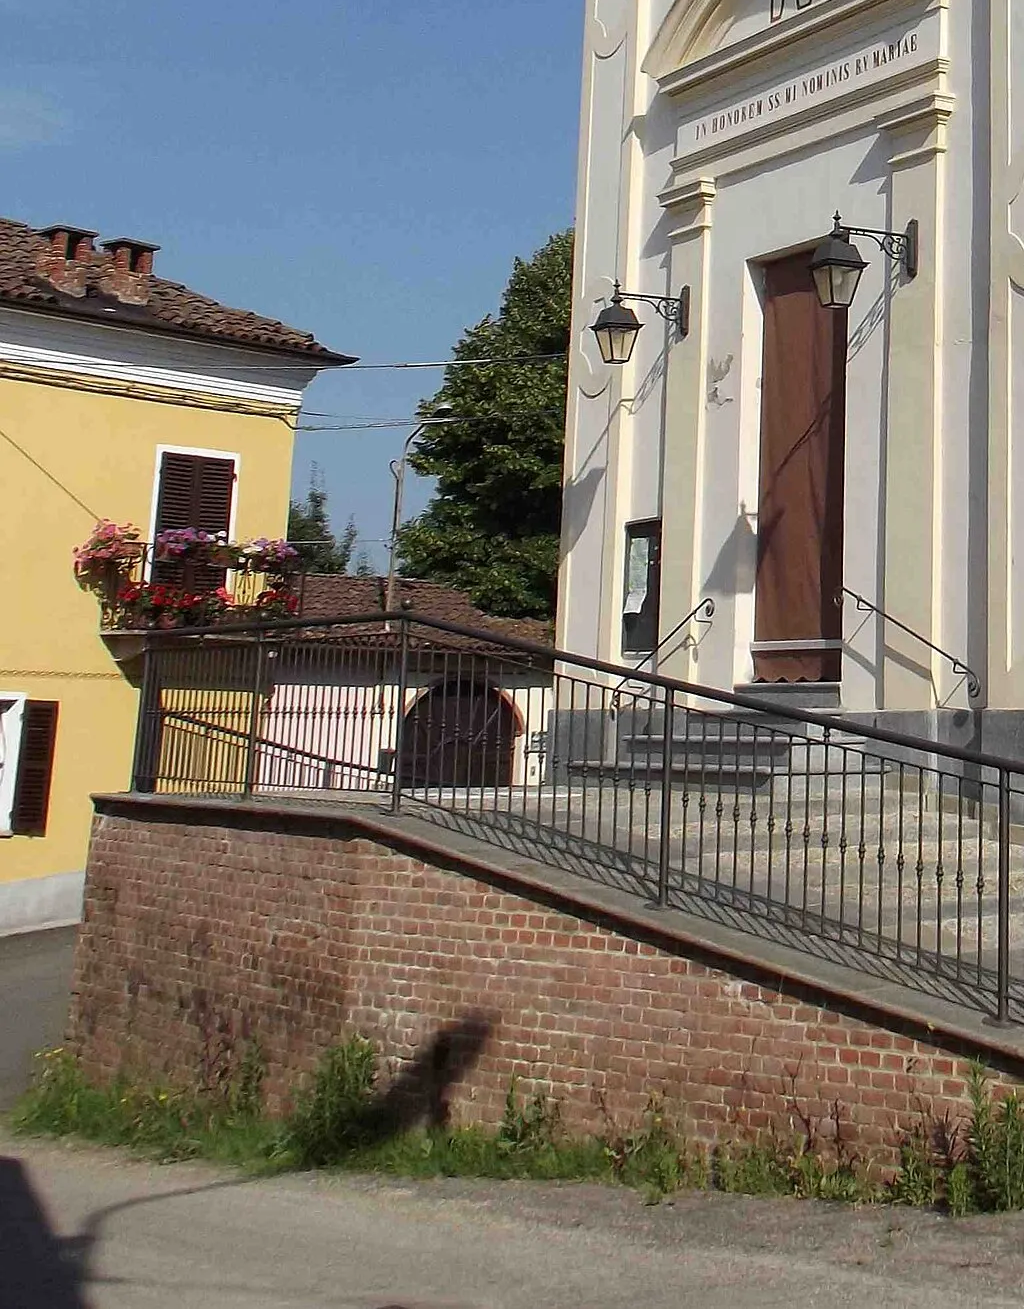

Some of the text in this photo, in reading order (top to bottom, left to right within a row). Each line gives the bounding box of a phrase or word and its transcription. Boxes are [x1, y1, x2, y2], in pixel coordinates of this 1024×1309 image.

[695, 124, 707, 141] IN
[712, 99, 763, 134] HONOREM
[802, 62, 850, 97] NOMINIS
[873, 33, 918, 69] MARIAE
